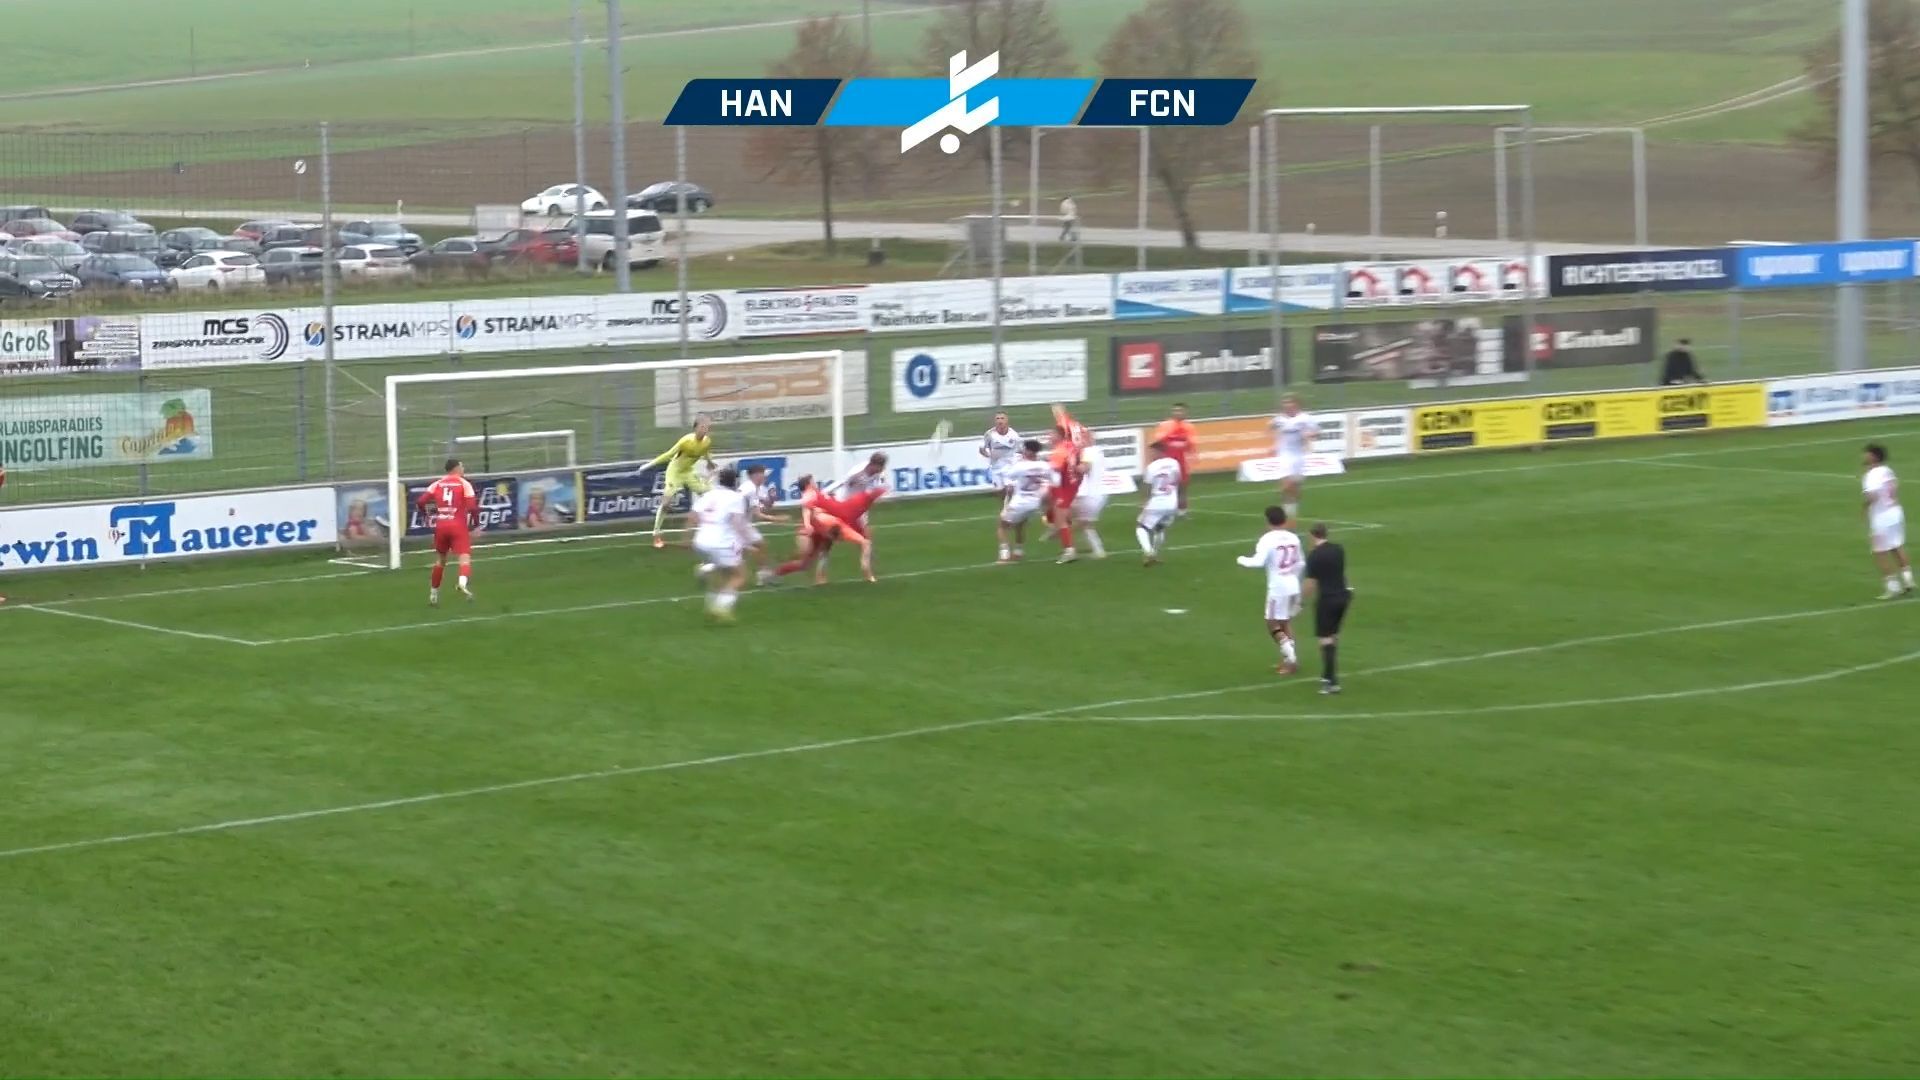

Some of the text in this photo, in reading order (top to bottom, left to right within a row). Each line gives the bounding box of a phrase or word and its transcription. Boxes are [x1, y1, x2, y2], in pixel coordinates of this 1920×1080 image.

[203, 317, 249, 336] MCS
[334, 319, 450, 341] STRAMAMPS
[2, 329, 50, 352] Groß
[1165, 347, 1273, 377] Einhel
[442, 487, 454, 506] 4
[110, 502, 317, 556] Mauerer
